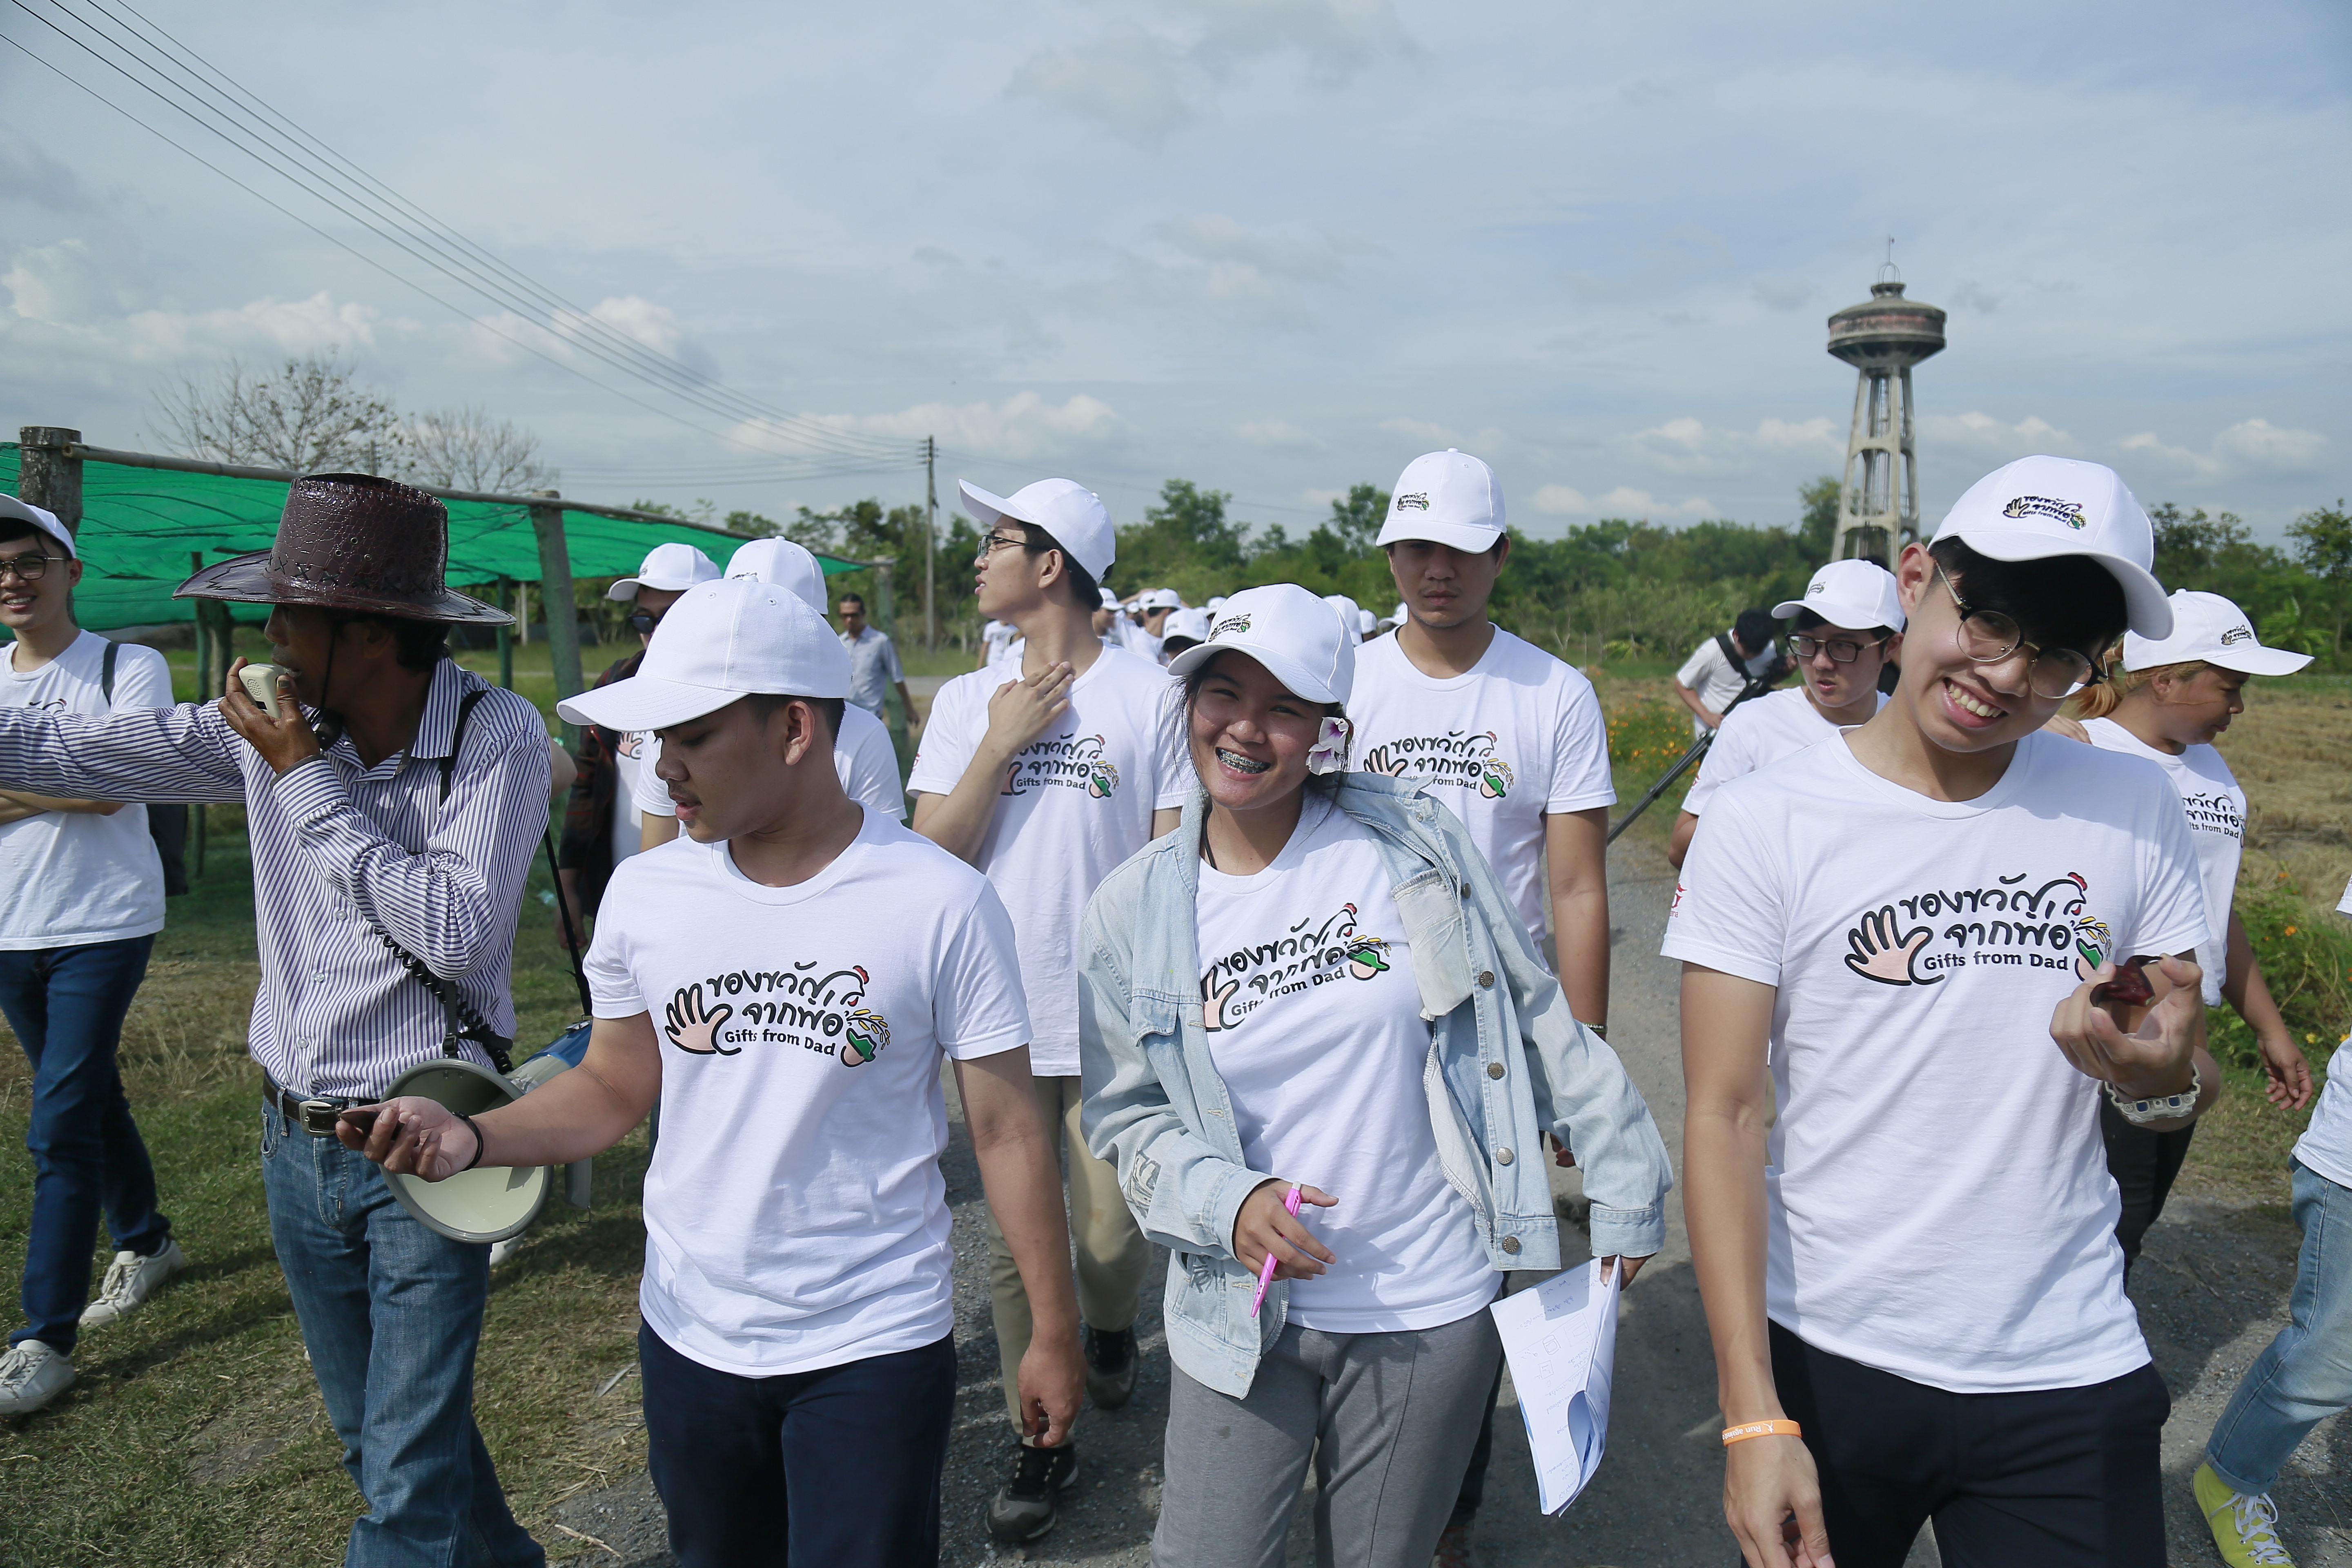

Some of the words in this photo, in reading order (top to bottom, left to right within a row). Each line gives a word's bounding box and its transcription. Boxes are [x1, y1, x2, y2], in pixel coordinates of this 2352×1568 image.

[1390, 730, 1494, 757] ของขวัญ
[1028, 750, 1090, 778] จากพ่อ
[1414, 747, 1482, 777] จากพ่อ
[1016, 777, 1040, 787] Gifts
[1066, 780, 1086, 790] Dad
[1456, 777, 1477, 790] Dad
[2201, 822, 2221, 833] from
[2224, 827, 2239, 839] Dad
[1899, 873, 2086, 919] ของขวัญ
[1944, 901, 2071, 950] จากพ่อ
[1217, 909, 1357, 976] ของขวัญ
[1924, 953, 1966, 971] Gifts
[1973, 951, 2022, 965] from
[2029, 953, 2069, 971] Dad
[706, 961, 865, 1005] ของขวัญ
[1311, 966, 1346, 986] Dad
[742, 990, 844, 1037] จากพ่อ
[724, 1029, 758, 1043] Gifts
[762, 1028, 800, 1046] from
[804, 1036, 836, 1056] Dad
[1724, 1428, 1744, 1440] against
[1745, 1425, 1762, 1433] Run
